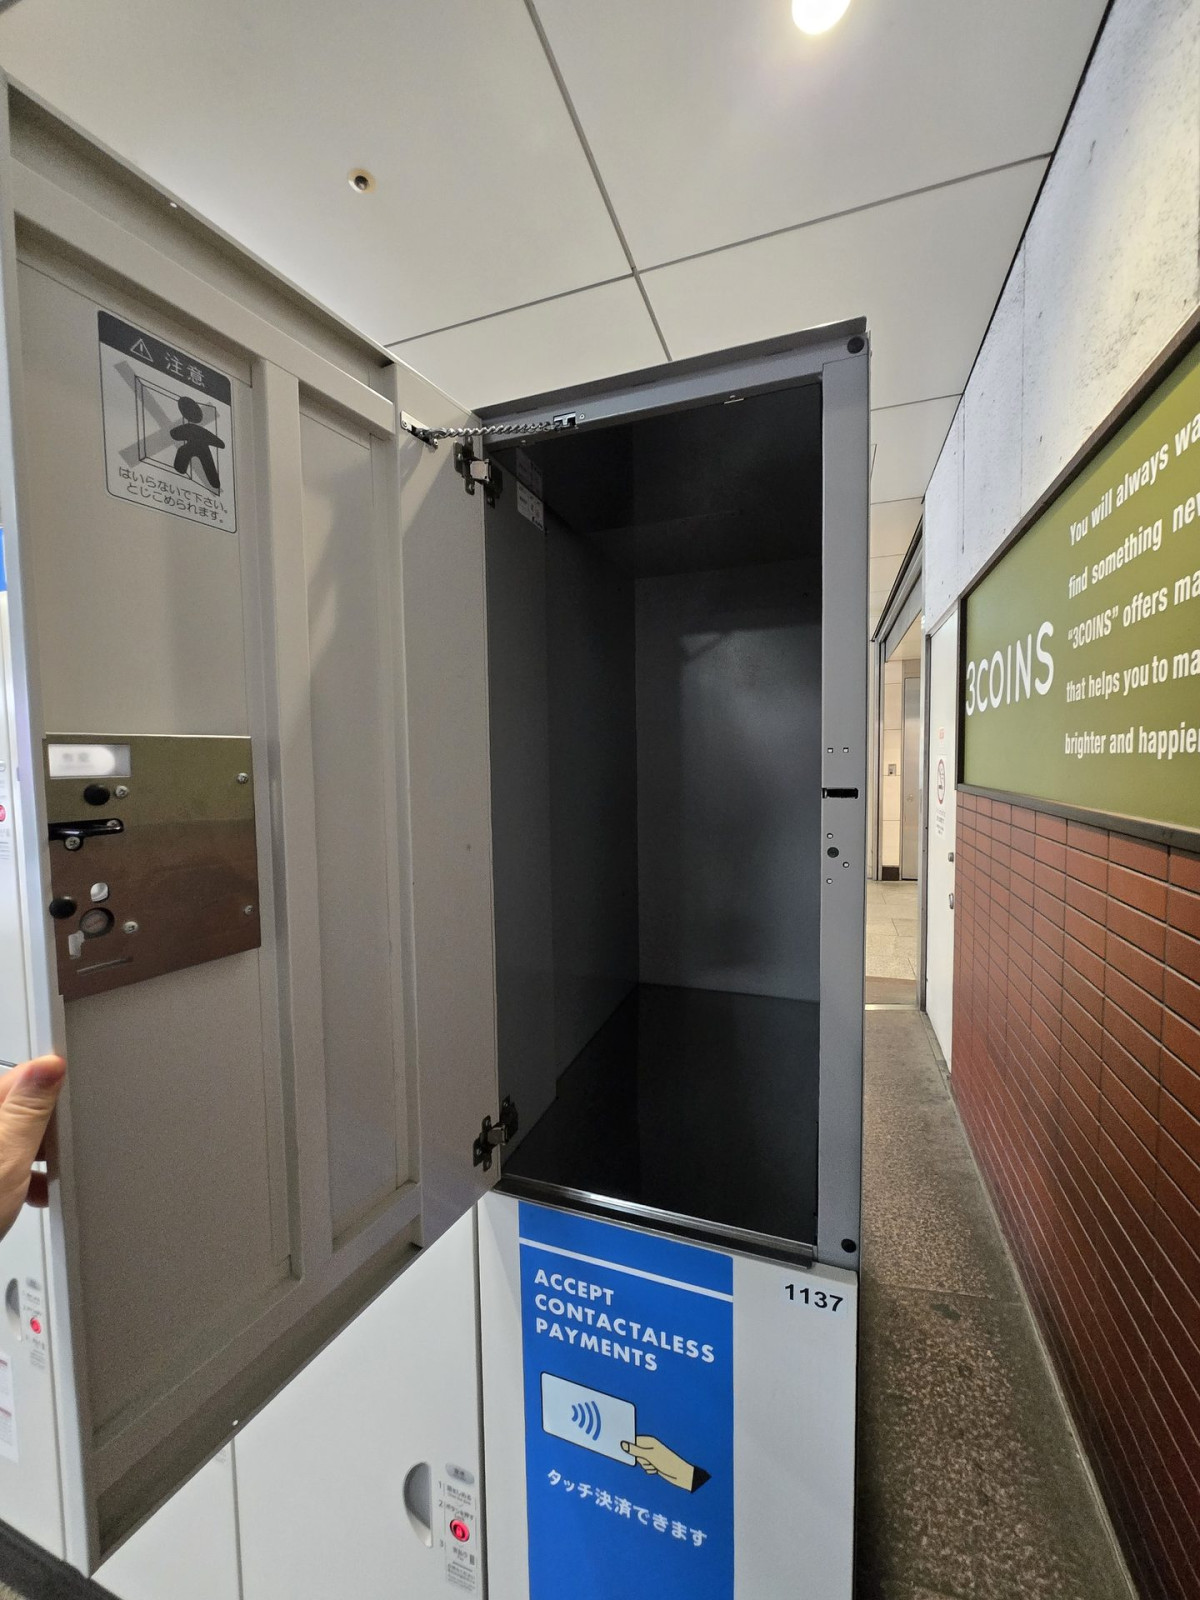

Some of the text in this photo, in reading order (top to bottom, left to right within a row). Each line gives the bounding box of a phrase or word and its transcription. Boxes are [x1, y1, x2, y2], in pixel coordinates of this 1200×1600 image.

[165, 352, 205, 388] 注意
[119, 466, 228, 514] はいらないで下さい。
[126, 482, 224, 523] とじこめられます。
[1070, 516, 1088, 546] You
[1091, 487, 1113, 528] will
[1116, 443, 1169, 507] always
[1068, 566, 1088, 599] find
[1091, 519, 1163, 584] something
[1123, 587, 1168, 627] offers
[965, 621, 1054, 716] 3COINS
[1066, 677, 1086, 702] that
[1088, 670, 1120, 700] helps
[1123, 664, 1149, 696] you
[1152, 655, 1168, 684] to
[1065, 731, 1107, 759] brighter
[1109, 726, 1134, 754] and
[534, 1269, 614, 1306] ACCEPT
[785, 1284, 843, 1312] 1137
[534, 1294, 715, 1363] CONTACTALESS
[536, 1317, 658, 1371] PAYMENTS
[547, 1469, 707, 1547] タッチ決済できます
